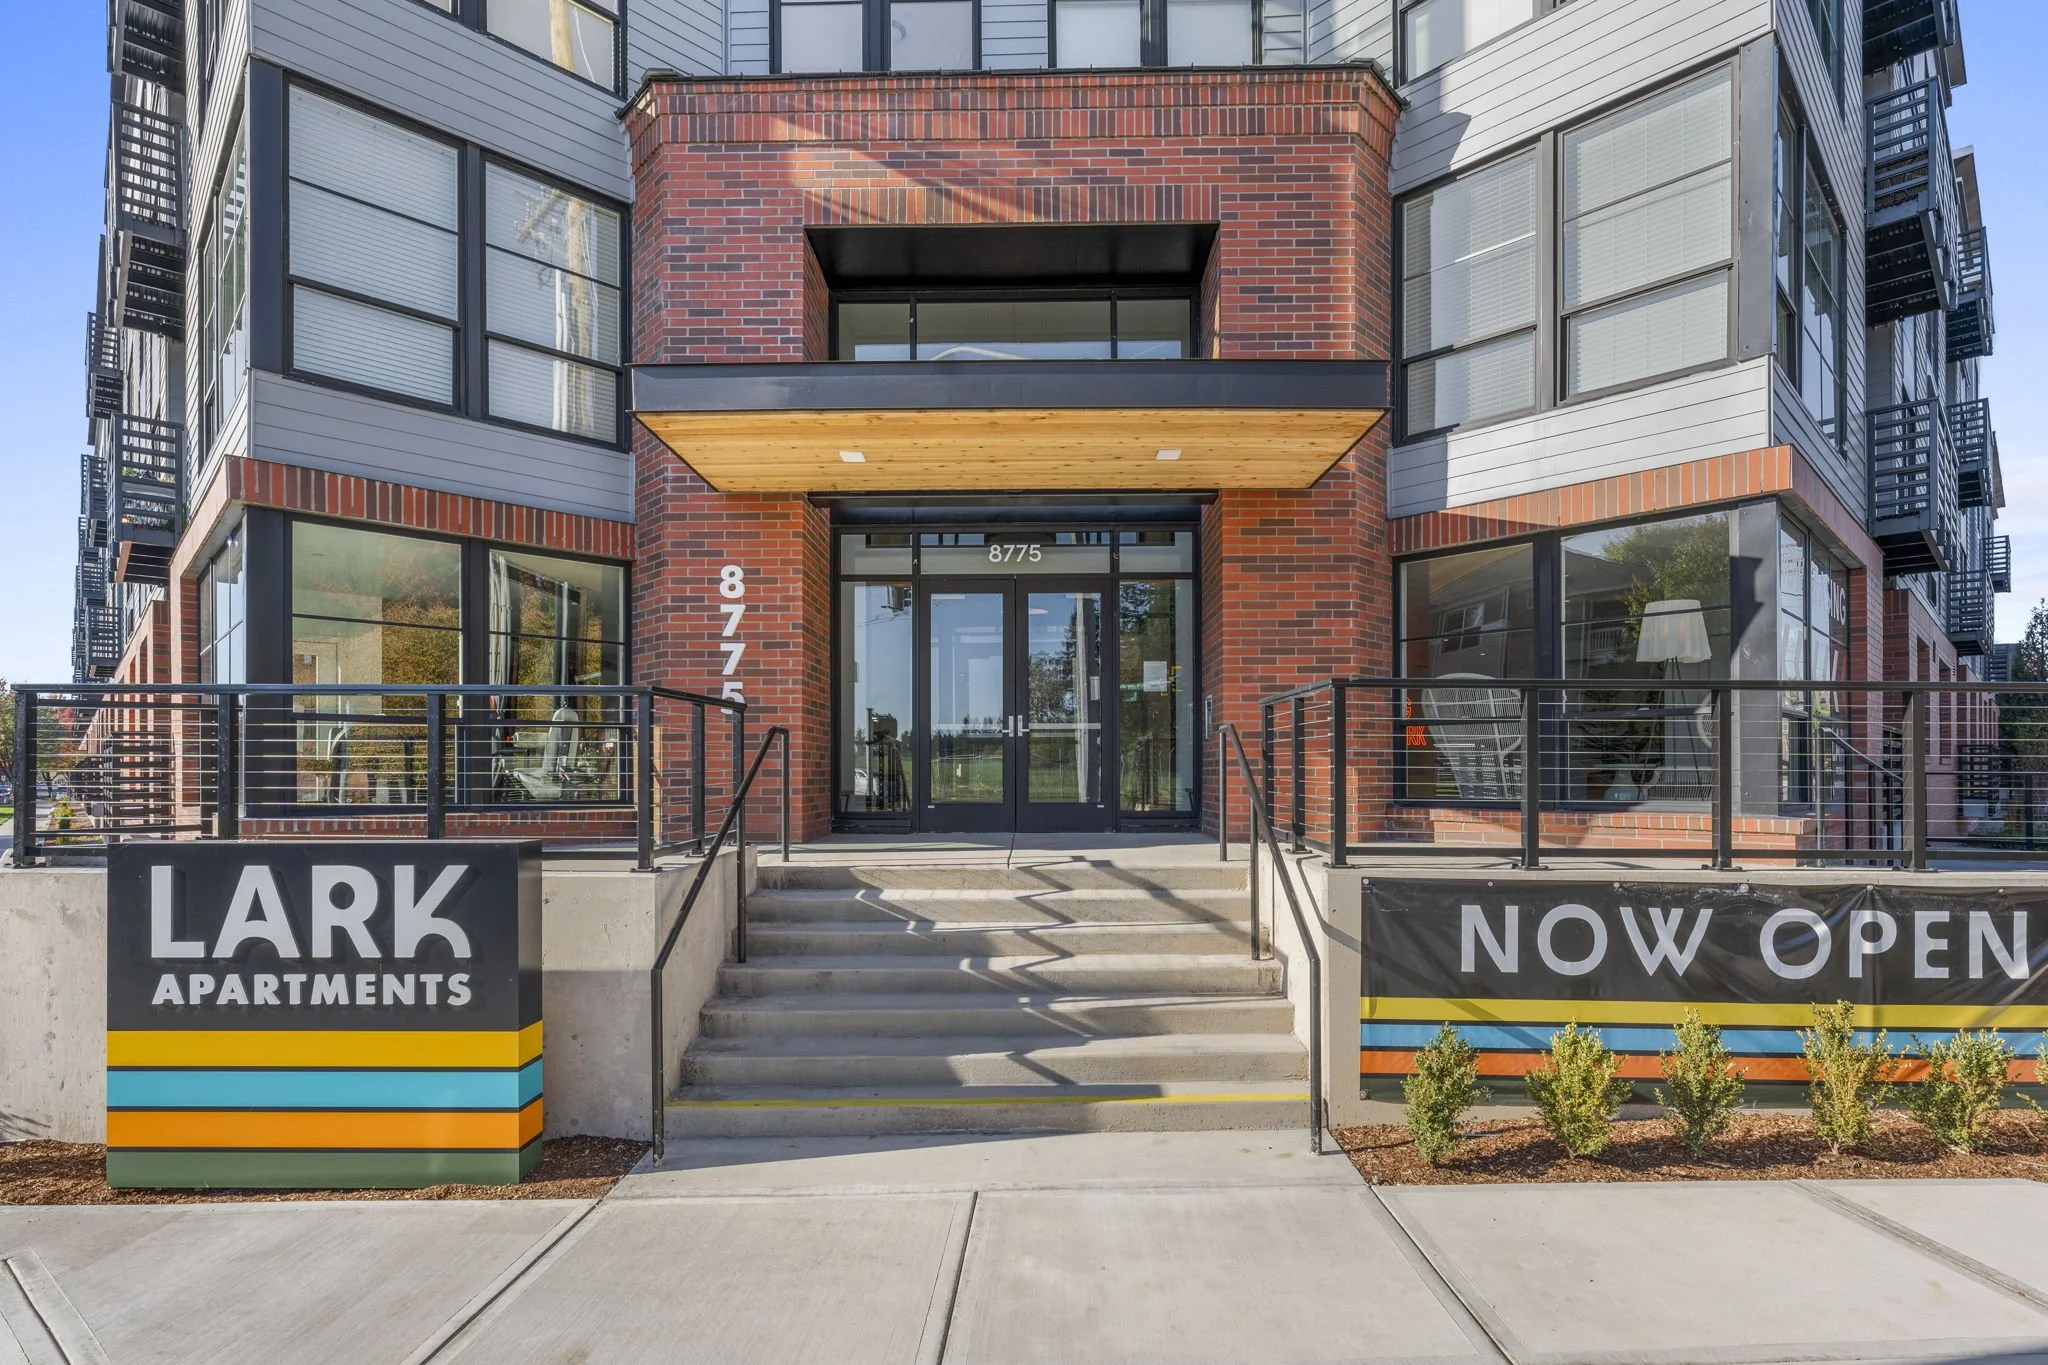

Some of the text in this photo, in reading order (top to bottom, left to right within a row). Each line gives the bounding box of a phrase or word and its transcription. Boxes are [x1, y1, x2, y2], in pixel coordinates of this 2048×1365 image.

[988, 544, 1042, 562] 8775
[719, 564, 746, 715] 8775
[151, 865, 471, 958] LARK
[1461, 904, 2031, 980] NOW OPEN
[151, 973, 471, 1006] APARTMENTS
